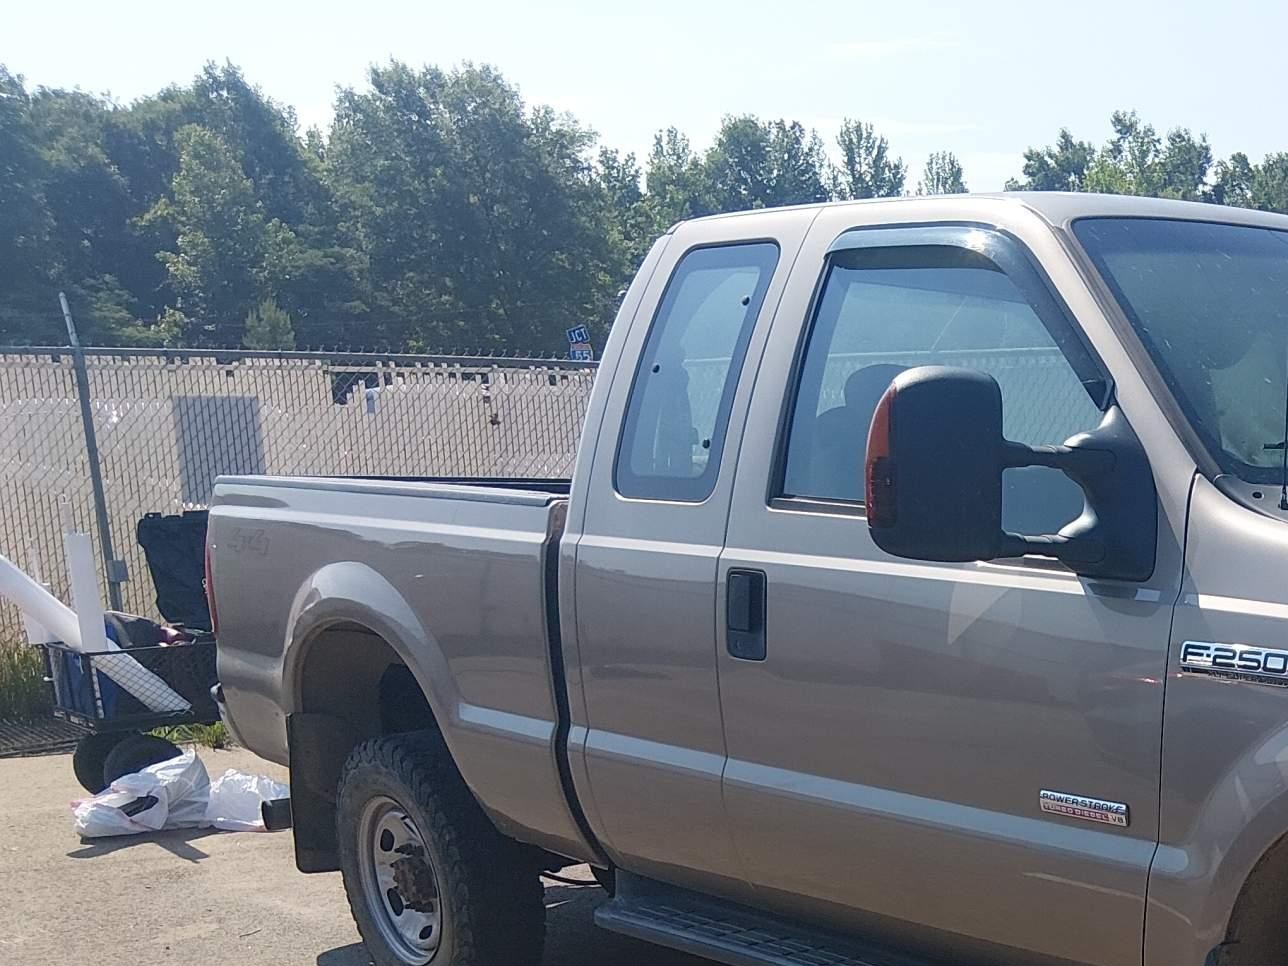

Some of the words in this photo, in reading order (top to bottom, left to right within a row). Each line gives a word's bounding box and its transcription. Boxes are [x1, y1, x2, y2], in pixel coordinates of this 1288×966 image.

[570, 328, 586, 342] JCT
[1182, 643, 1288, 674] F-250
[1080, 799, 1124, 815] STROKE
